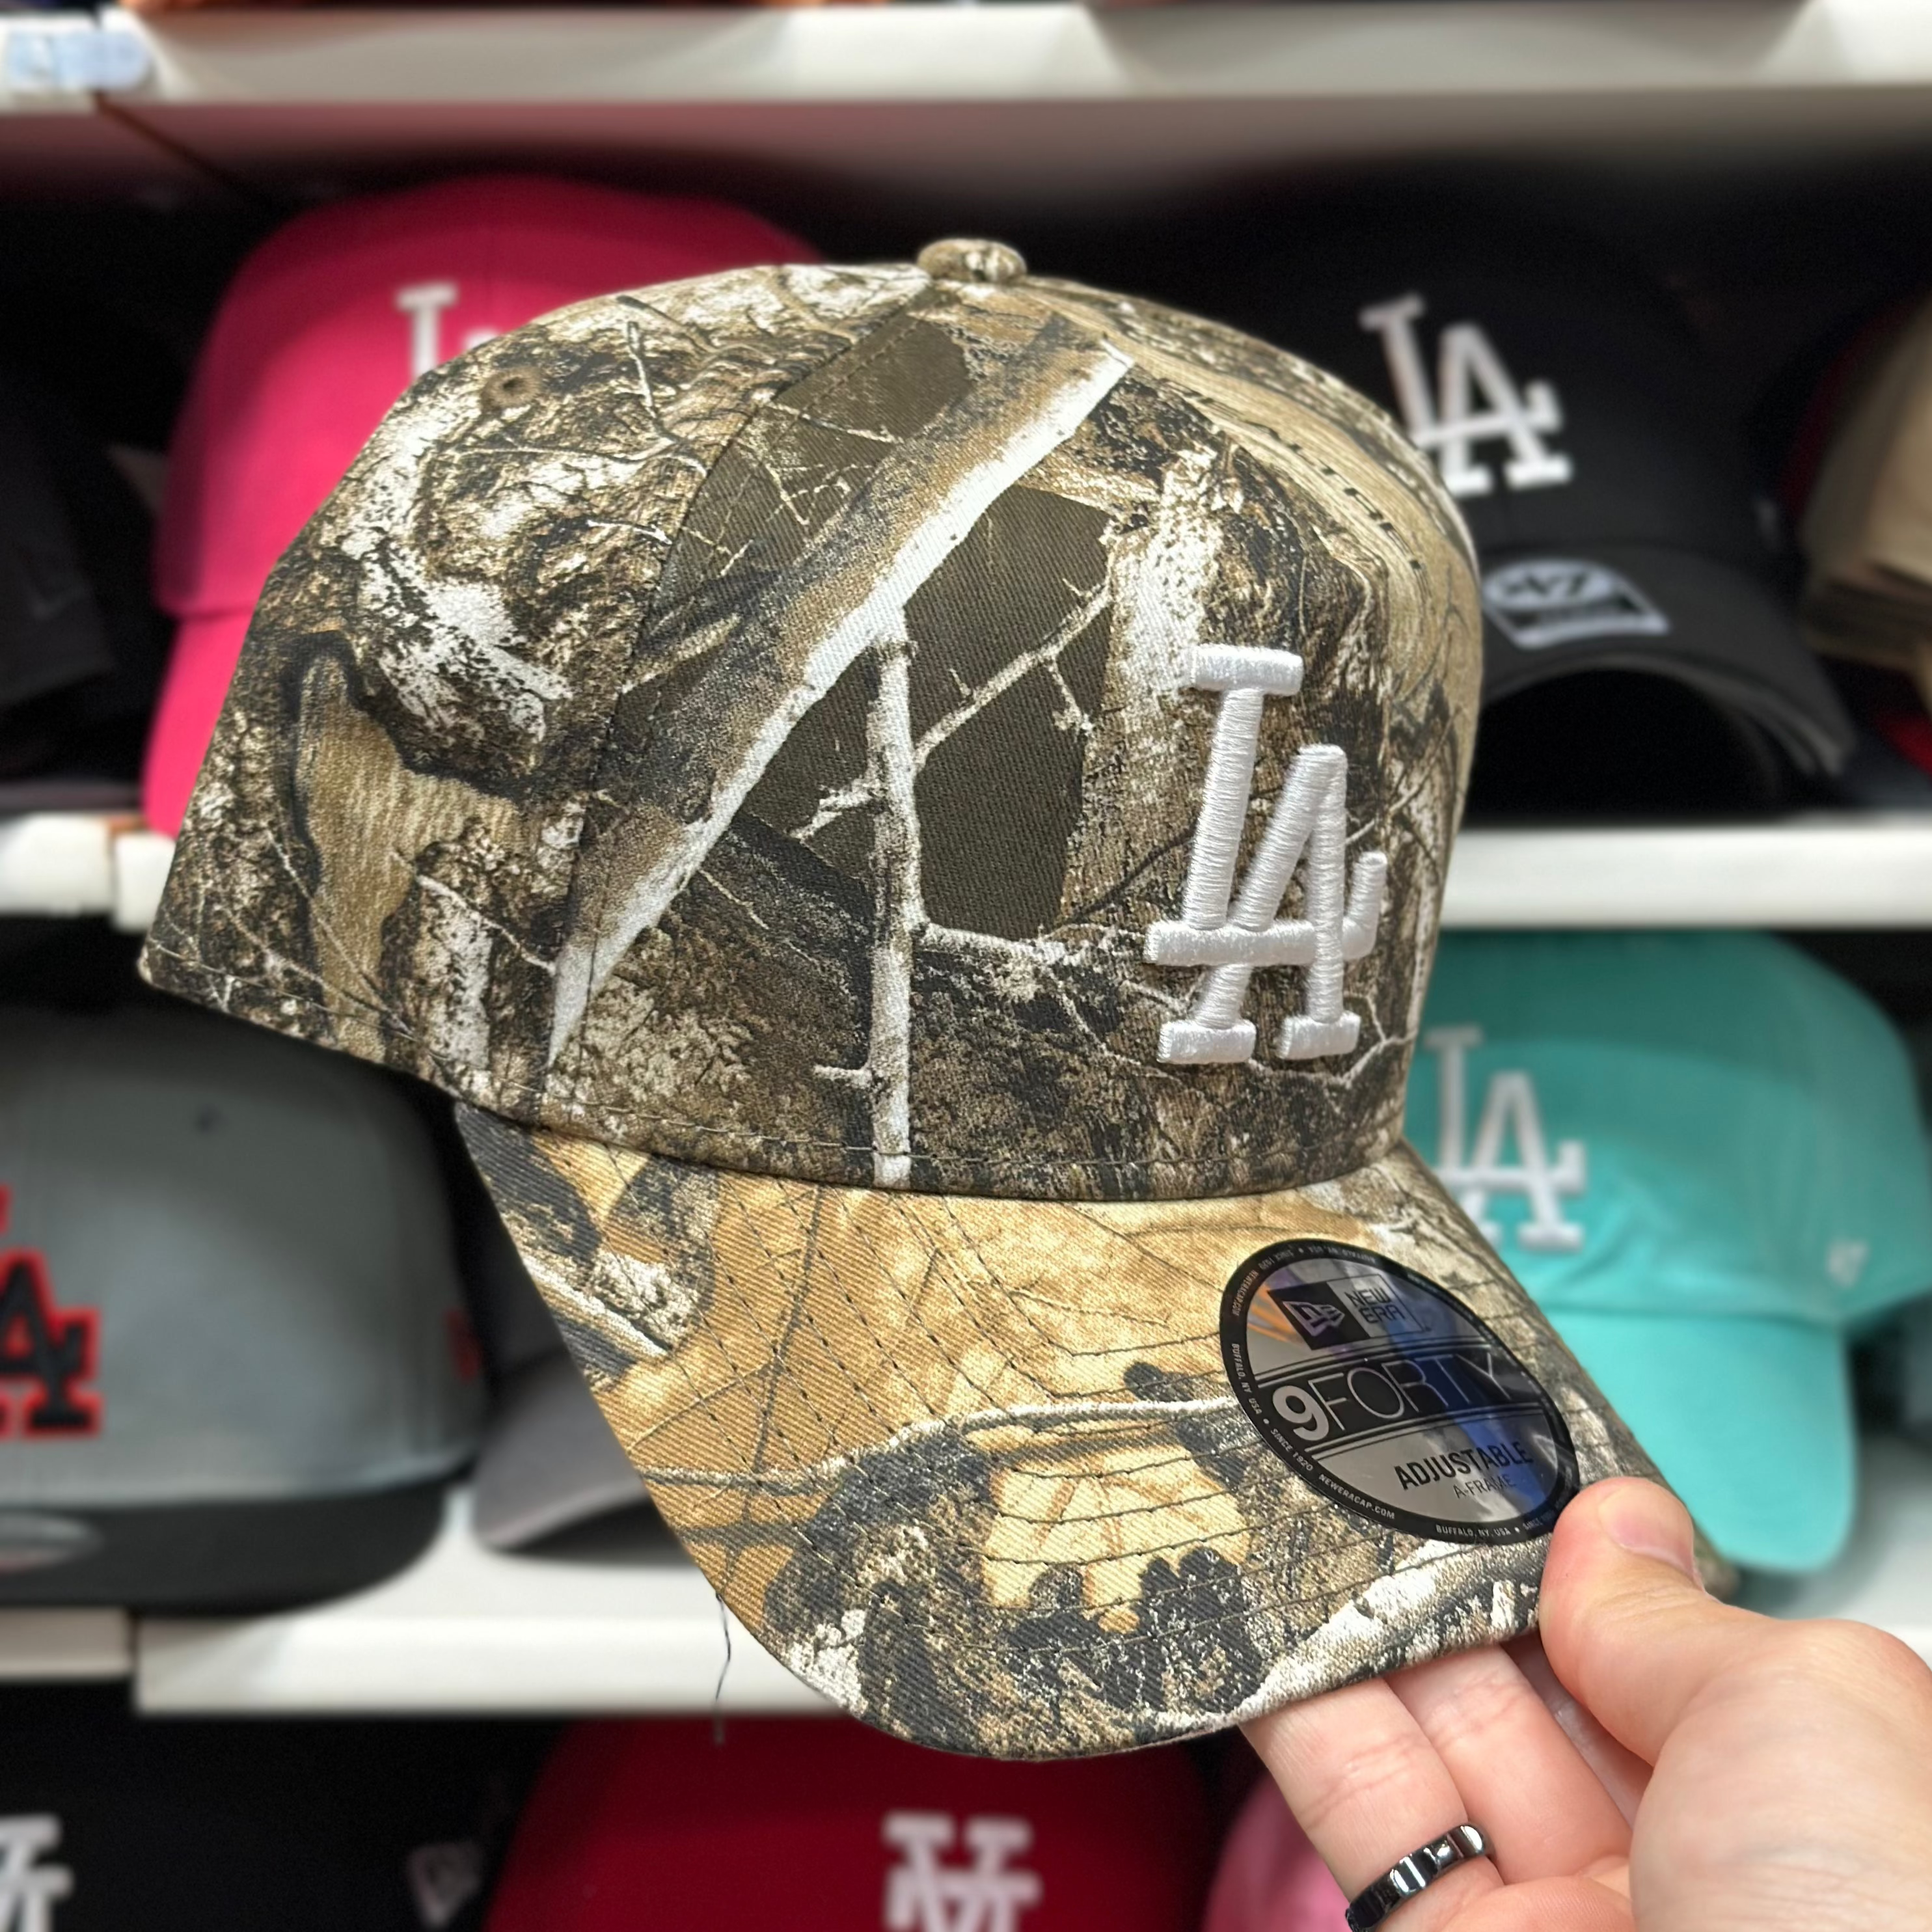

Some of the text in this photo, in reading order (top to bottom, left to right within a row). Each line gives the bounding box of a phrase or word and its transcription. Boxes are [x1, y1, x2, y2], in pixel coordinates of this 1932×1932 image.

[1359, 292, 1573, 498] LA
[1143, 642, 1388, 1065] LA
[1423, 1023, 1586, 1253] LA
[1344, 1288, 1391, 1307] NEW
[1359, 1304, 1406, 1324] ERA
[1272, 1352, 1512, 1441] 9FORTY
[1248, 1398, 1262, 1415] USA
[1270, 1428, 1293, 1452] SINCE
[1292, 1451, 1314, 1471] 1920
[1318, 1474, 1395, 1519] NEWERACAP.COM
[1394, 1441, 1533, 1490] ADJUSTABLE
[1452, 1473, 1517, 1499] A-FRAME
[1496, 1527, 1512, 1536] USA
